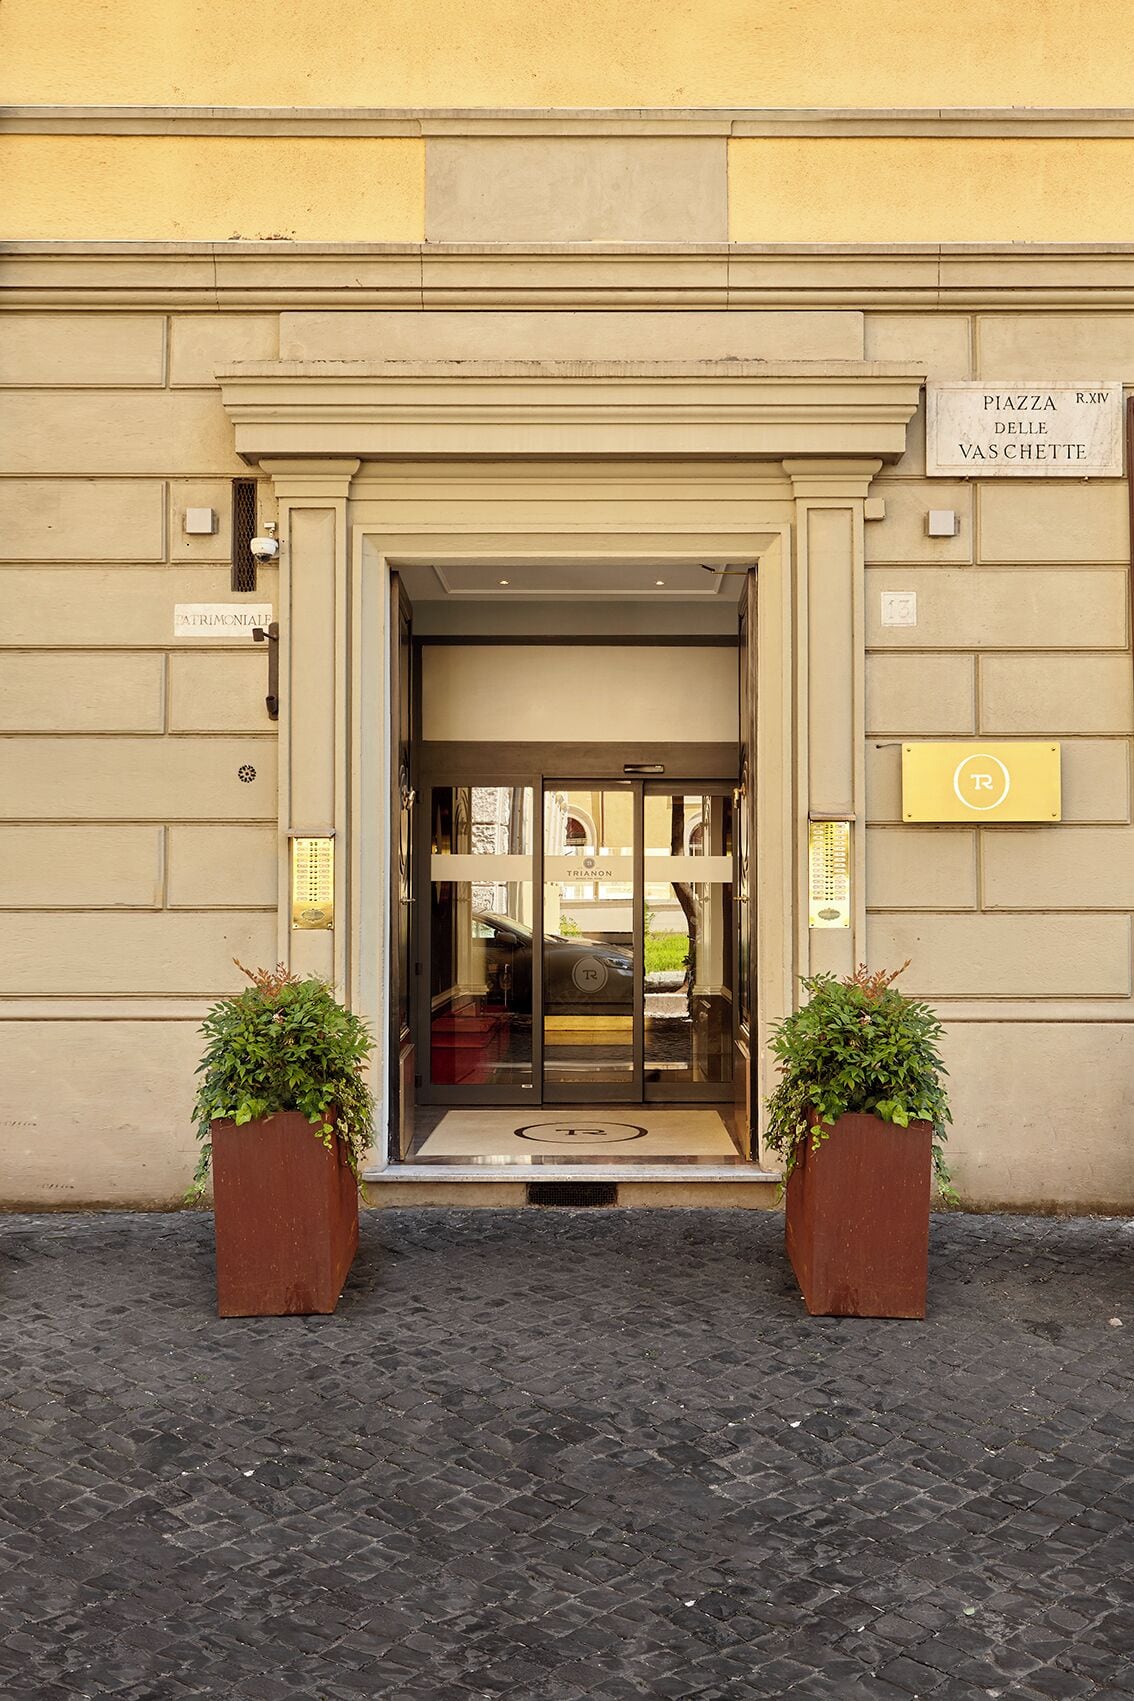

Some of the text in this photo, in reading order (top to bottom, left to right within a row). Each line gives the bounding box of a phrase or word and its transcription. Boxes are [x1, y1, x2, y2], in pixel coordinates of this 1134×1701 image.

[984, 395, 1057, 410] PIAZZA
[1076, 392, 1109, 403] R.XIV
[994, 421, 1048, 434] DELLE
[958, 443, 1087, 459] VASCHETTE
[970, 773, 993, 790] TR
